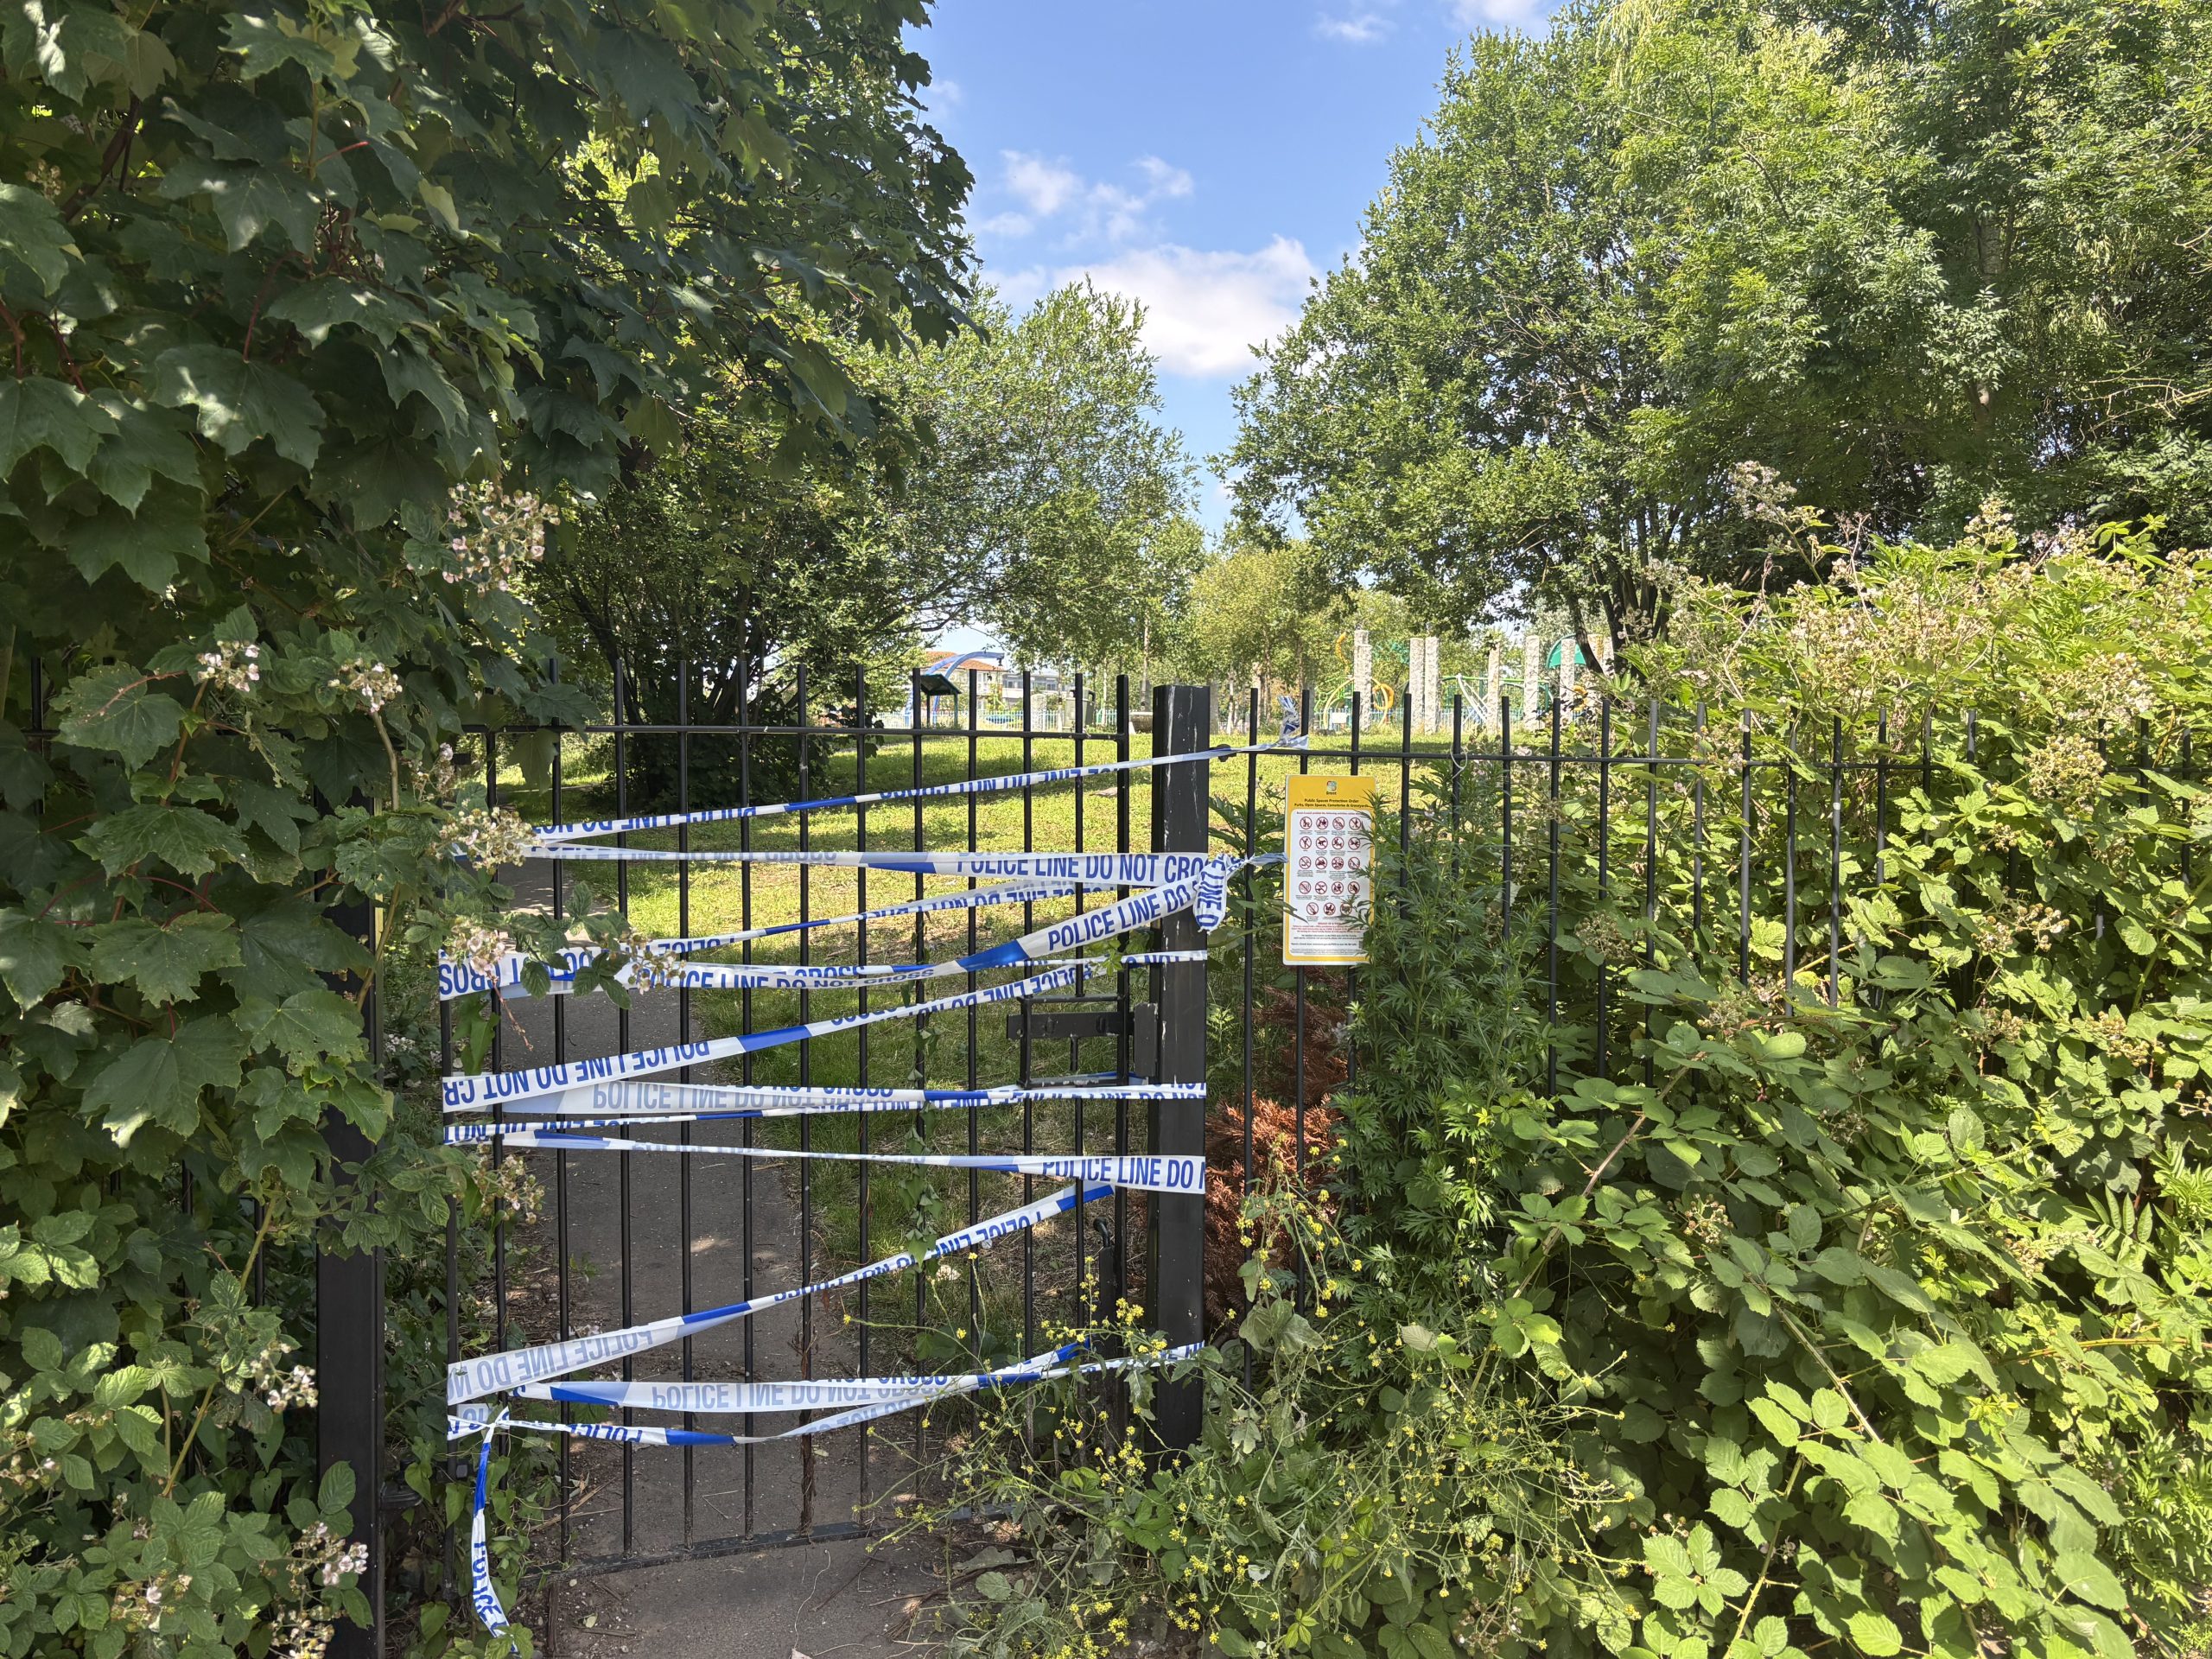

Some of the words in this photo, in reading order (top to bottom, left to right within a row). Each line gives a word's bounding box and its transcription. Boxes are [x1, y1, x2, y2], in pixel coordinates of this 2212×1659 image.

[1035, 856, 1079, 878] LINE
[1085, 855, 1113, 880] DO
[1119, 854, 1159, 882] NOT
[1164, 855, 1210, 883] CRO
[1048, 909, 1116, 951] POLICE
[1117, 893, 1161, 929] LINE
[1163, 884, 1191, 913] DO
[658, 938, 734, 957] OLICE
[721, 974, 769, 988] LINE
[864, 969, 934, 984] CROSS
[575, 1053, 626, 1083] LINE
[633, 1039, 710, 1071] POLICE
[483, 1071, 531, 1100] NOT
[535, 1065, 569, 1090] DO
[1042, 1158, 1112, 1182] POLICE
[1117, 1157, 1160, 1186] LINE
[1166, 1160, 1193, 1188] DO
[976, 1211, 1041, 1240] OLICE
